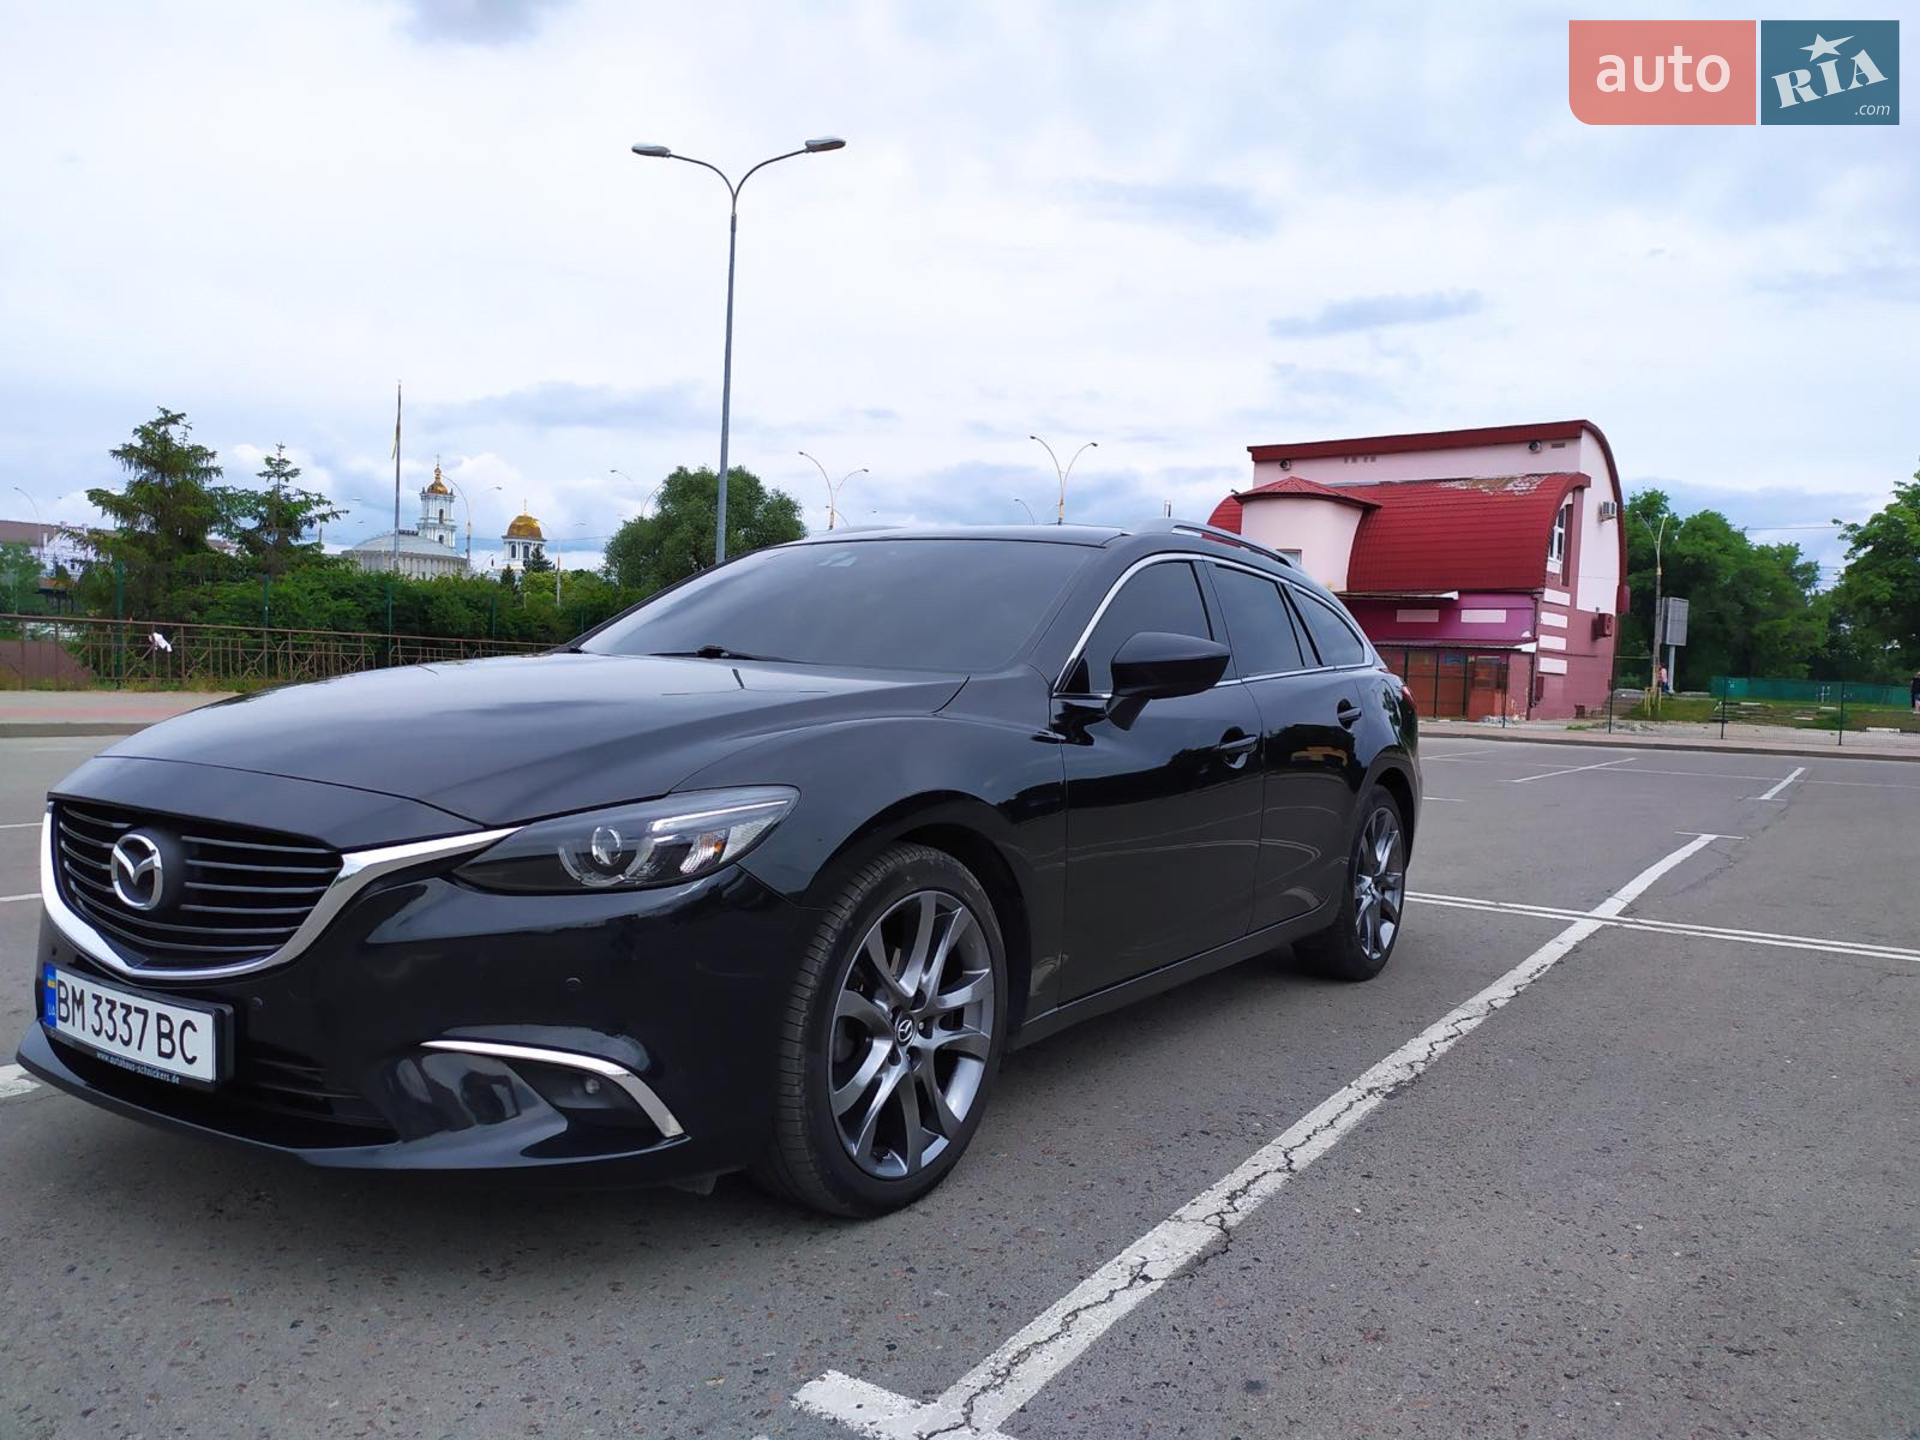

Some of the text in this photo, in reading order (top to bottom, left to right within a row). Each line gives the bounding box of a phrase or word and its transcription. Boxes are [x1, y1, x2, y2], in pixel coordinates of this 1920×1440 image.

[57, 979, 198, 1065] BM 3337 BC
